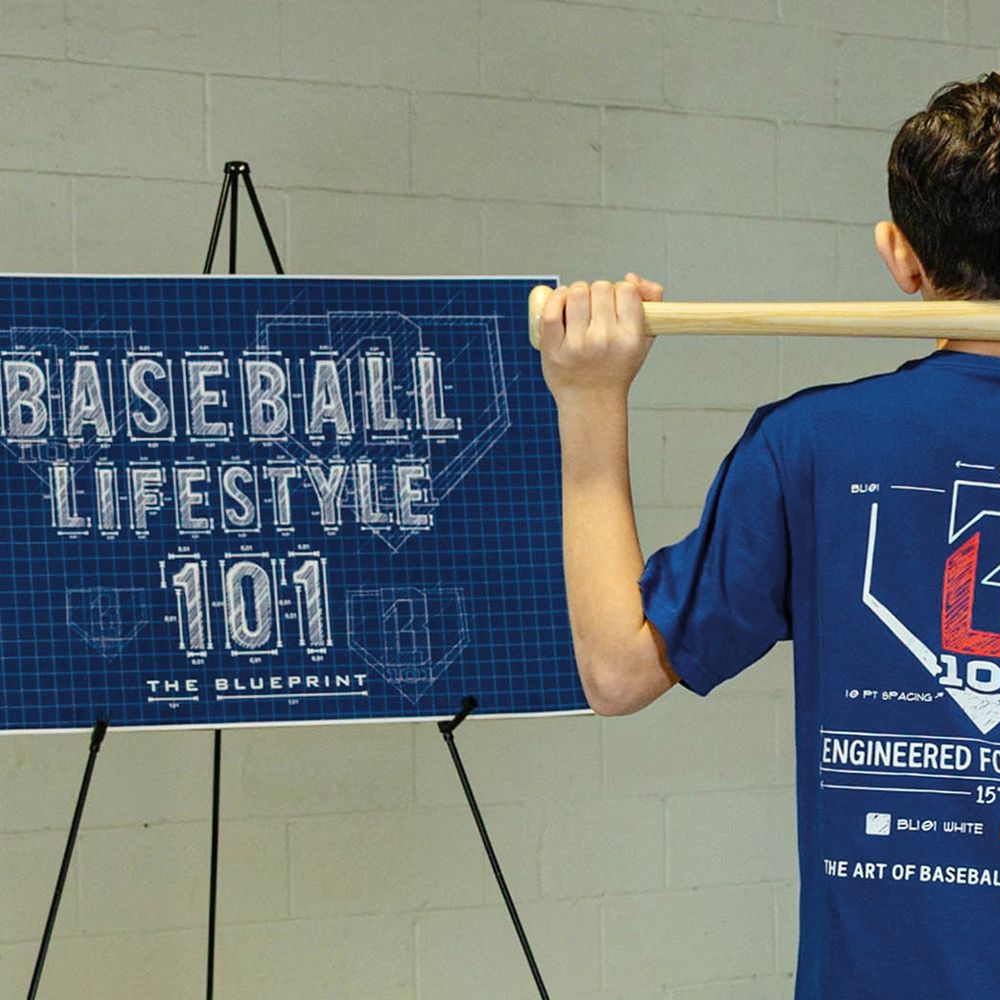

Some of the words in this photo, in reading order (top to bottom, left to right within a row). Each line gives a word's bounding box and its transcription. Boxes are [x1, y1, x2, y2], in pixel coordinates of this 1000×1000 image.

[3, 357, 456, 437] BASEBALL
[54, 464, 429, 530] LIFESTYLE
[172, 560, 325, 649] 101
[147, 680, 199, 692] THE
[215, 674, 368, 690] BLUEPRINT
[863, 690, 878, 700] PT
[881, 691, 933, 702] SPACING
[822, 737, 972, 771] ENGINEERED
[943, 821, 984, 834] WHITE
[824, 859, 848, 877] THE
[852, 862, 887, 879] ART
[891, 863, 917, 881] OF
